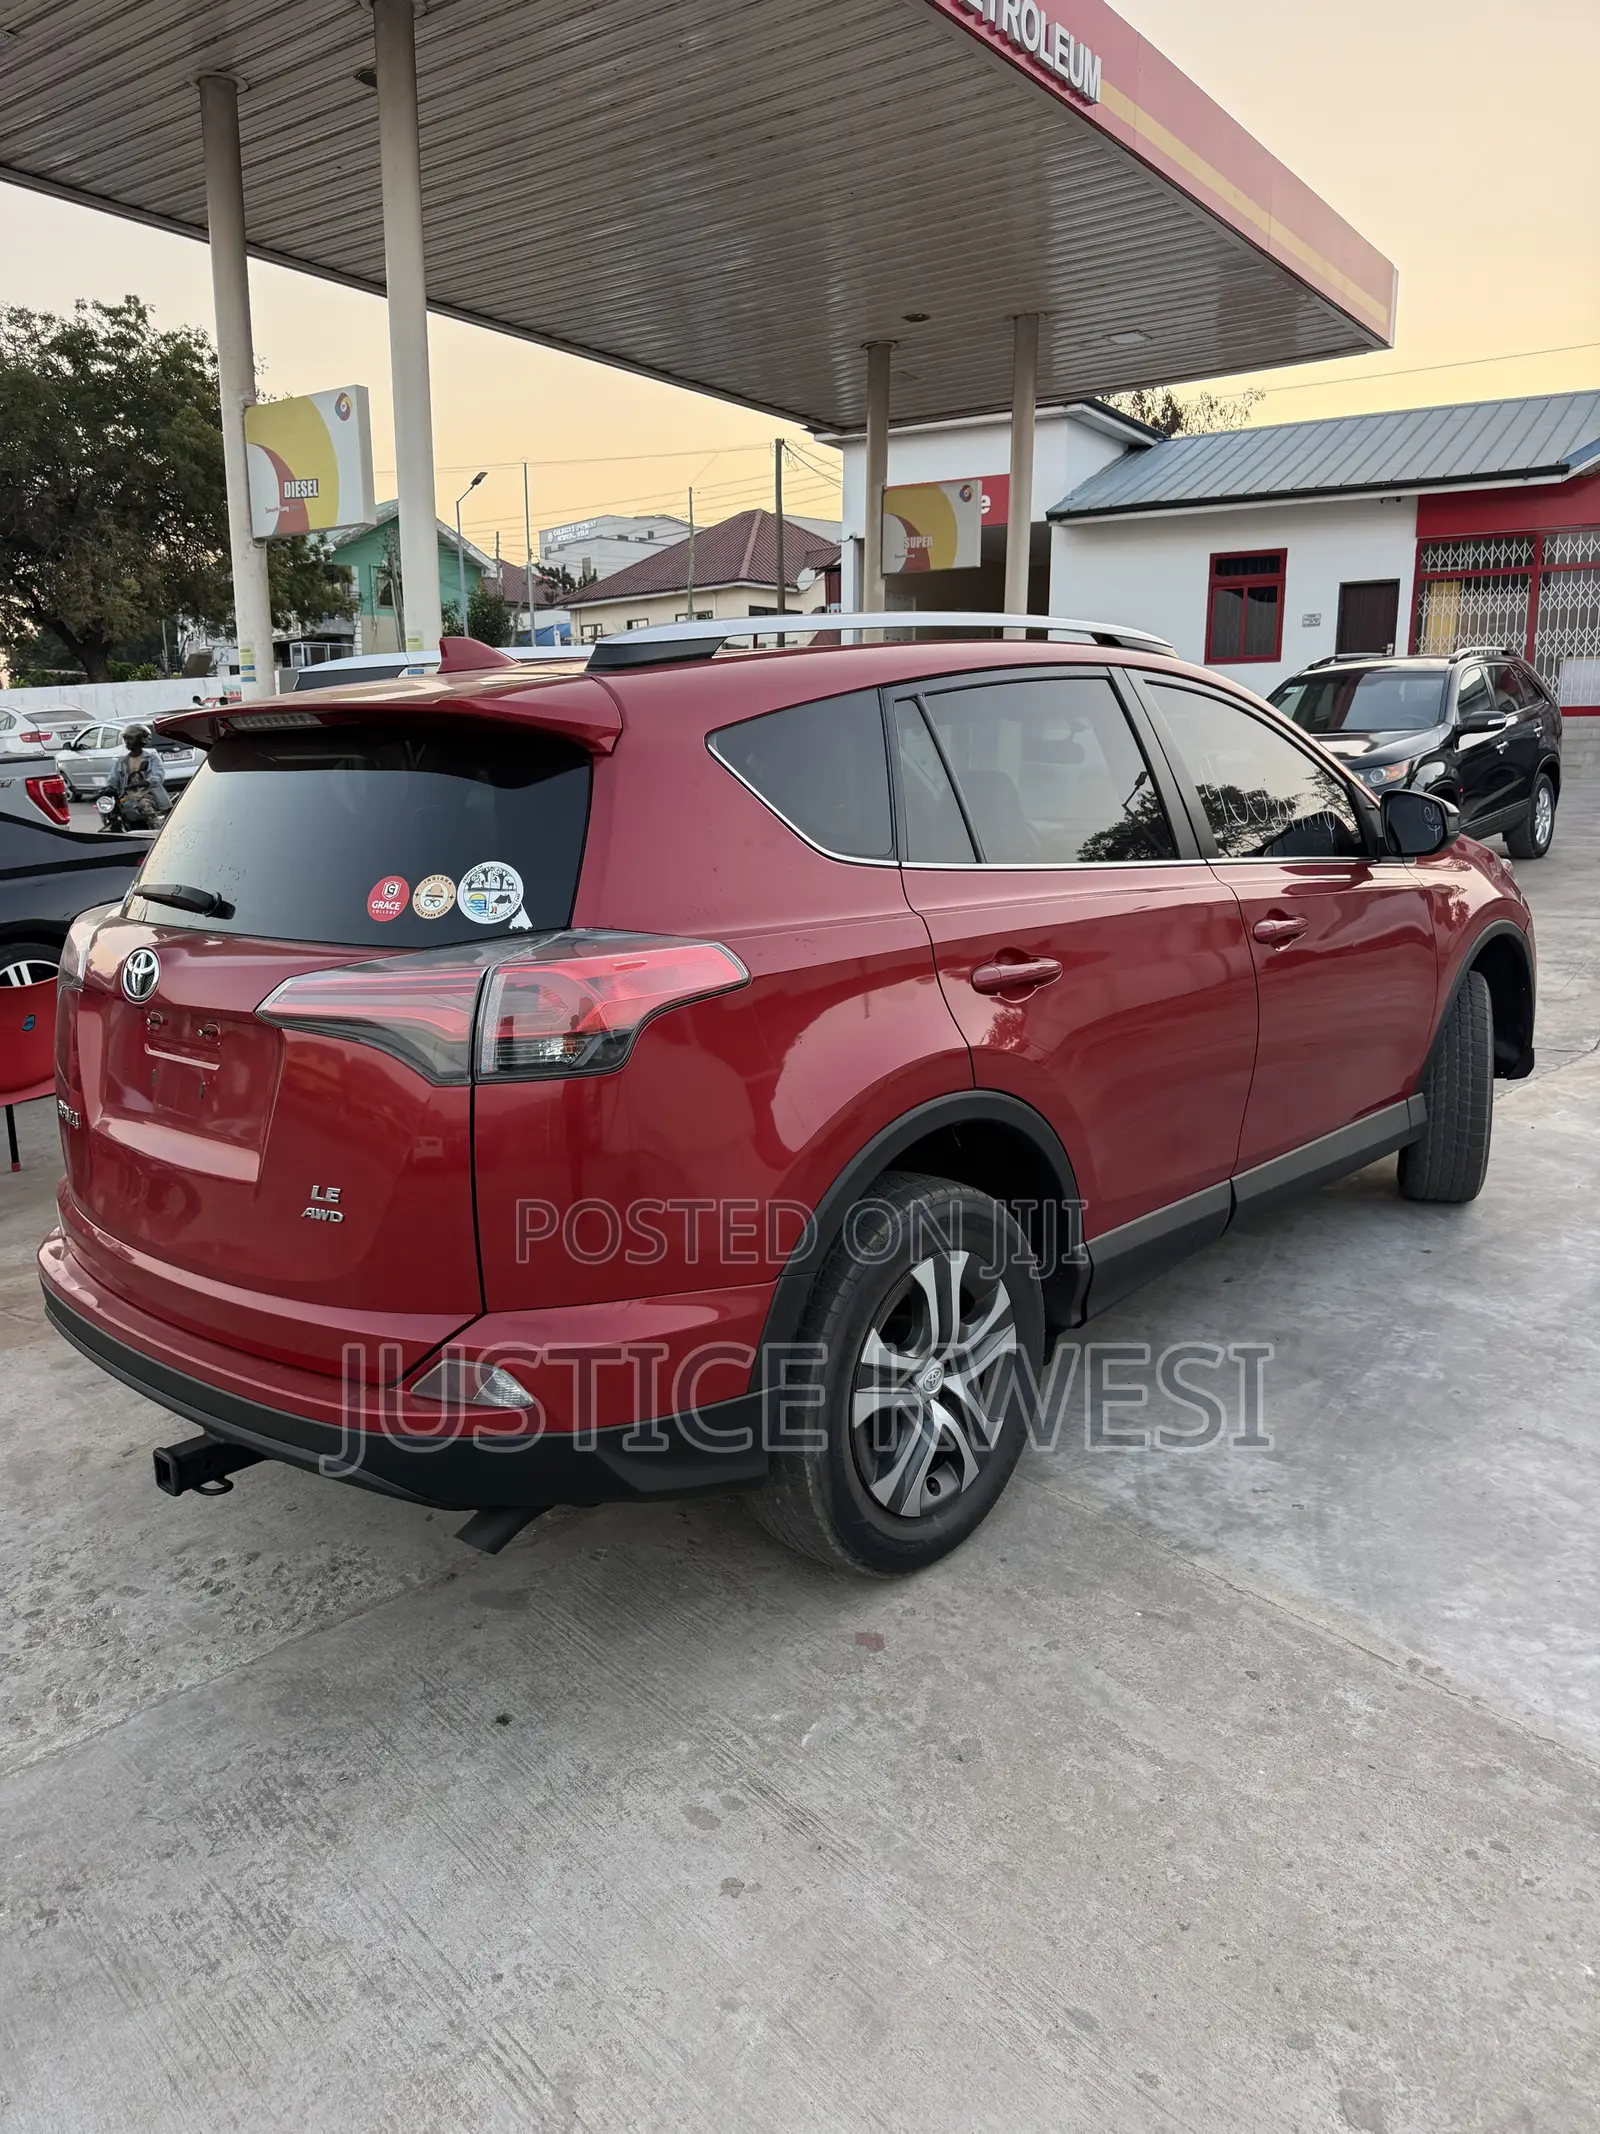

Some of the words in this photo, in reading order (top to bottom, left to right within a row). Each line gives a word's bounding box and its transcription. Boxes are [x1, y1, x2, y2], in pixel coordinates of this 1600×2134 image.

[283, 479, 319, 499] DIESEL
[904, 536, 933, 549] SUPER
[371, 900, 402, 911] GRACE
[311, 1185, 341, 1204] LE
[301, 1207, 344, 1224] AWD
